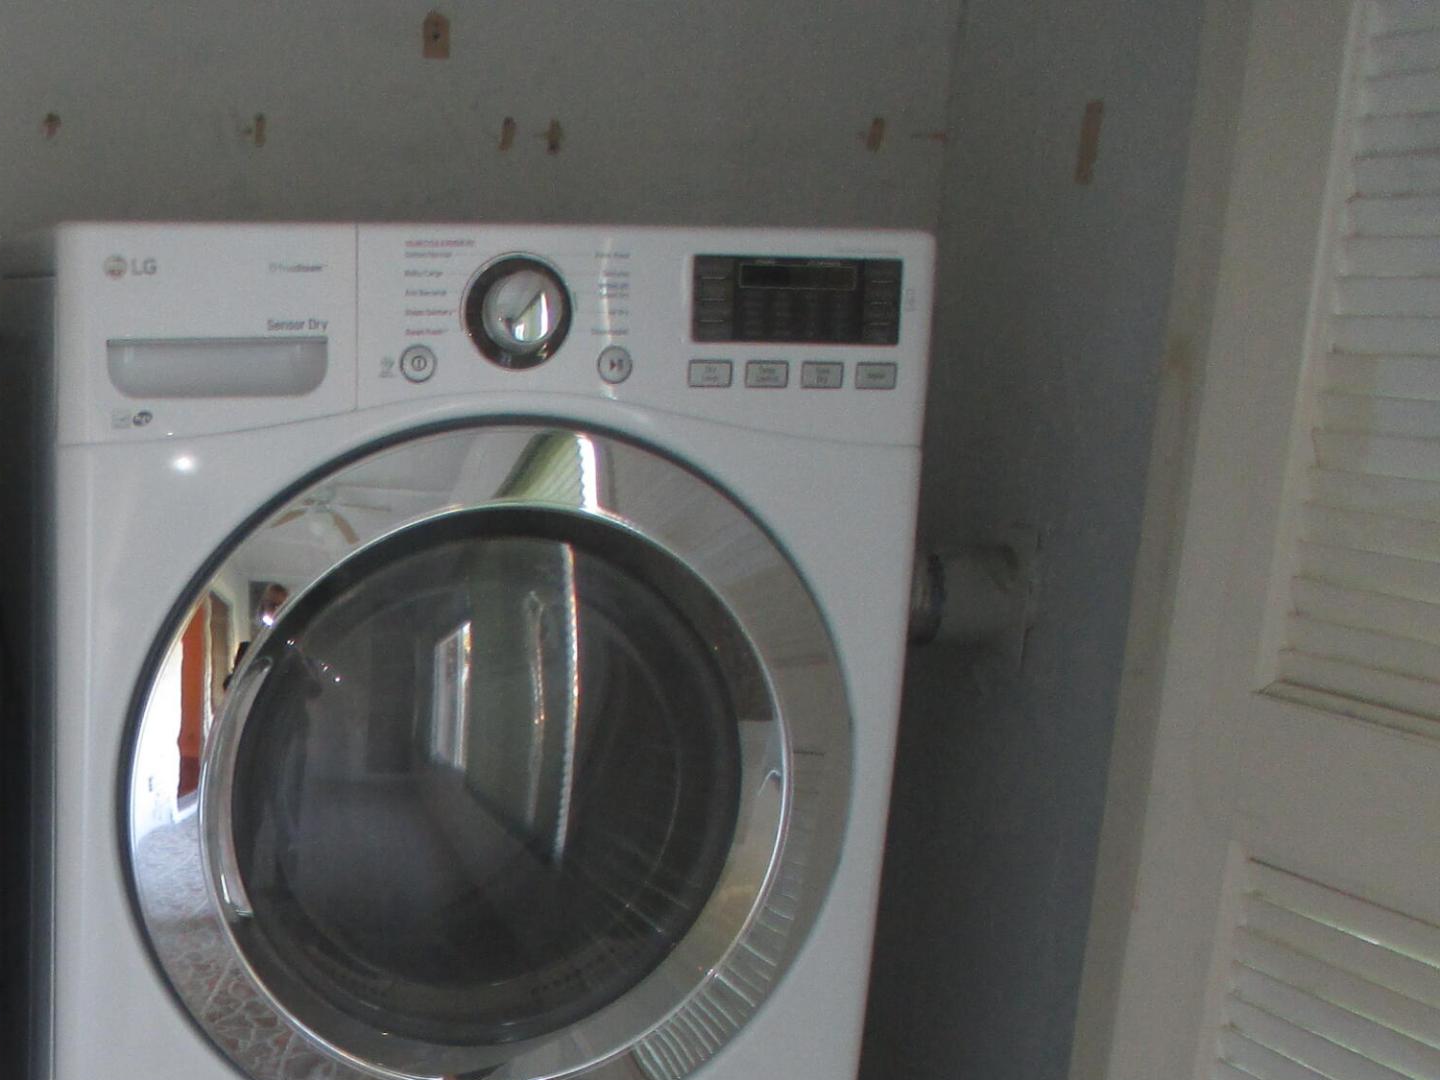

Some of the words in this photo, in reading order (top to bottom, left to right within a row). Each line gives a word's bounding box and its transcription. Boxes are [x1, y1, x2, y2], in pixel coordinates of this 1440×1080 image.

[131, 258, 158, 276] LG
[267, 319, 305, 331] Sensor
[308, 318, 329, 333] Dry
